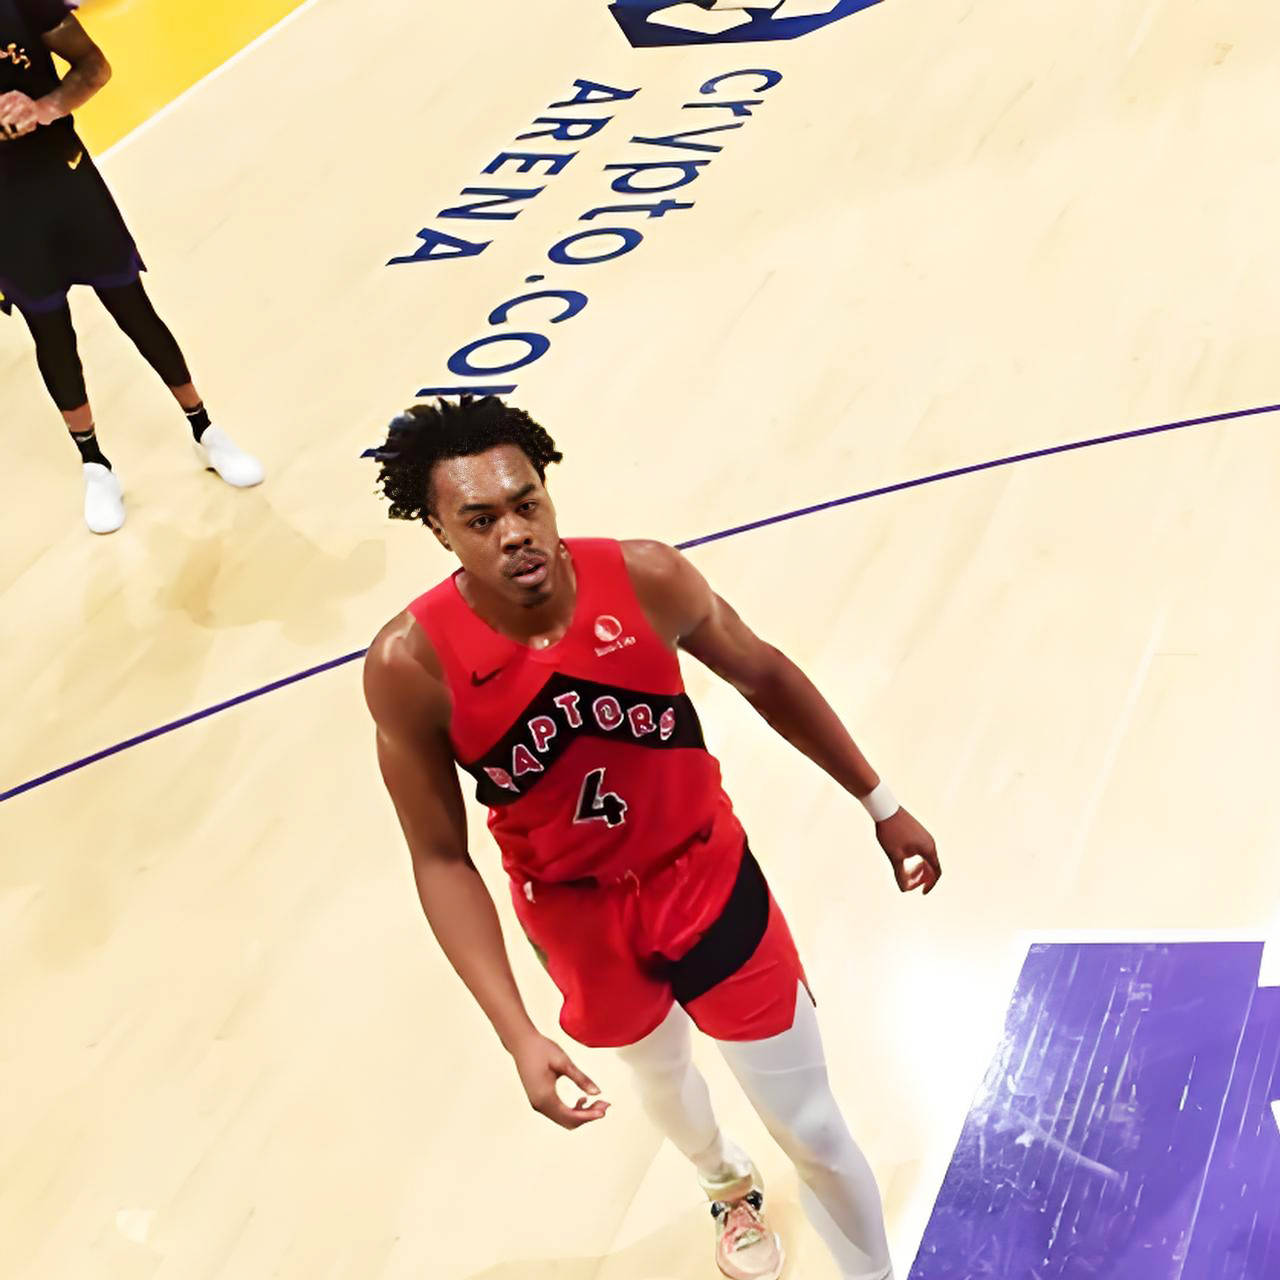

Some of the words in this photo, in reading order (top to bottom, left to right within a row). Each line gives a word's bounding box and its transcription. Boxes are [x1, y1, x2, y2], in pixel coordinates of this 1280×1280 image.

[385, 78, 642, 267] ARENA
[414, 68, 783, 397] crypto.co
[572, 767, 628, 828] 4
